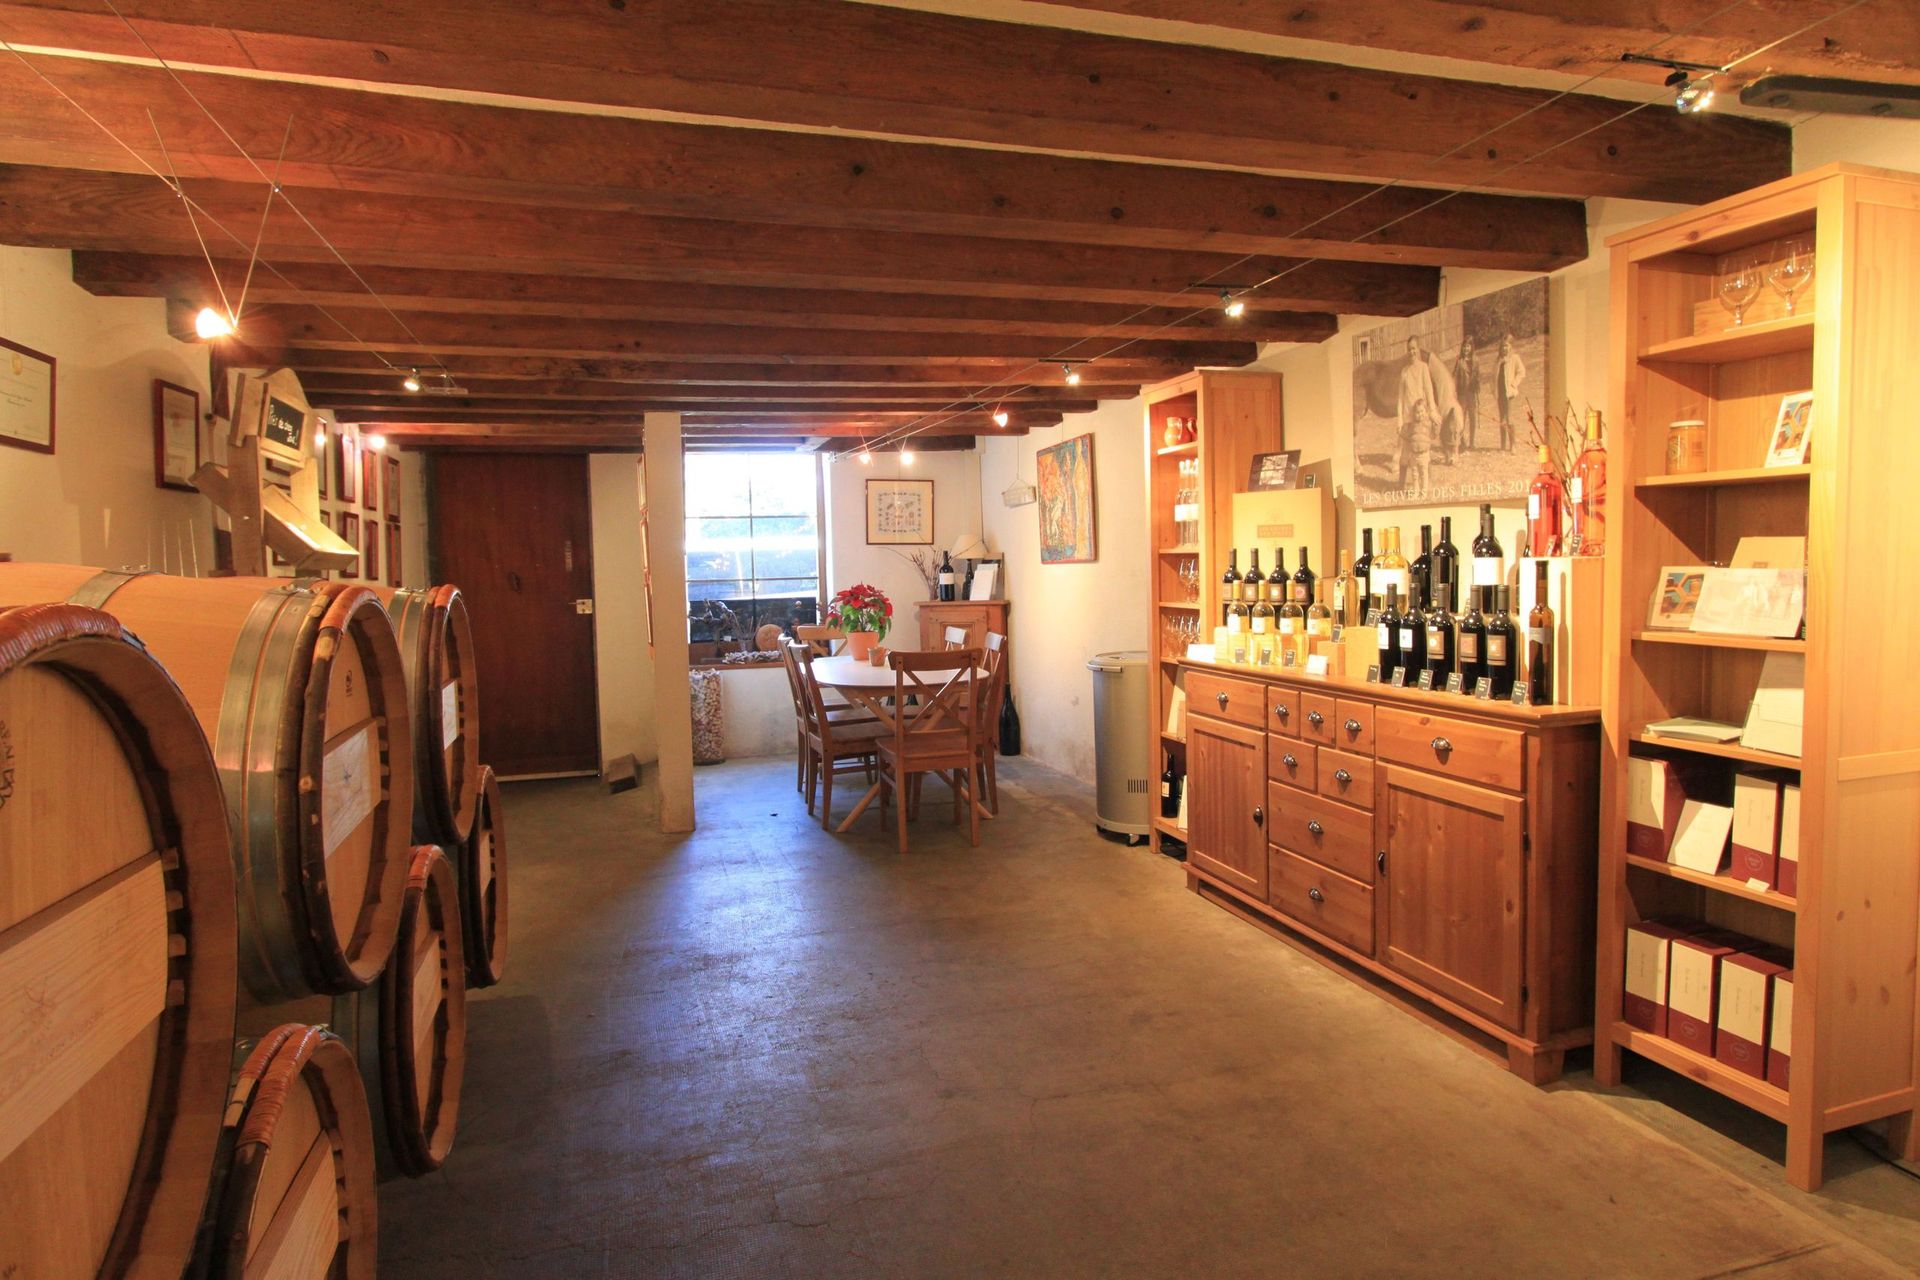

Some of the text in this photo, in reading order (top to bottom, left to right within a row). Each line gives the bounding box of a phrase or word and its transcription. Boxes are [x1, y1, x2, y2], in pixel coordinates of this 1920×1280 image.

[1363, 491, 1381, 505] LES
[1432, 486, 1455, 500] DES
[1460, 481, 1503, 498] FILLES
